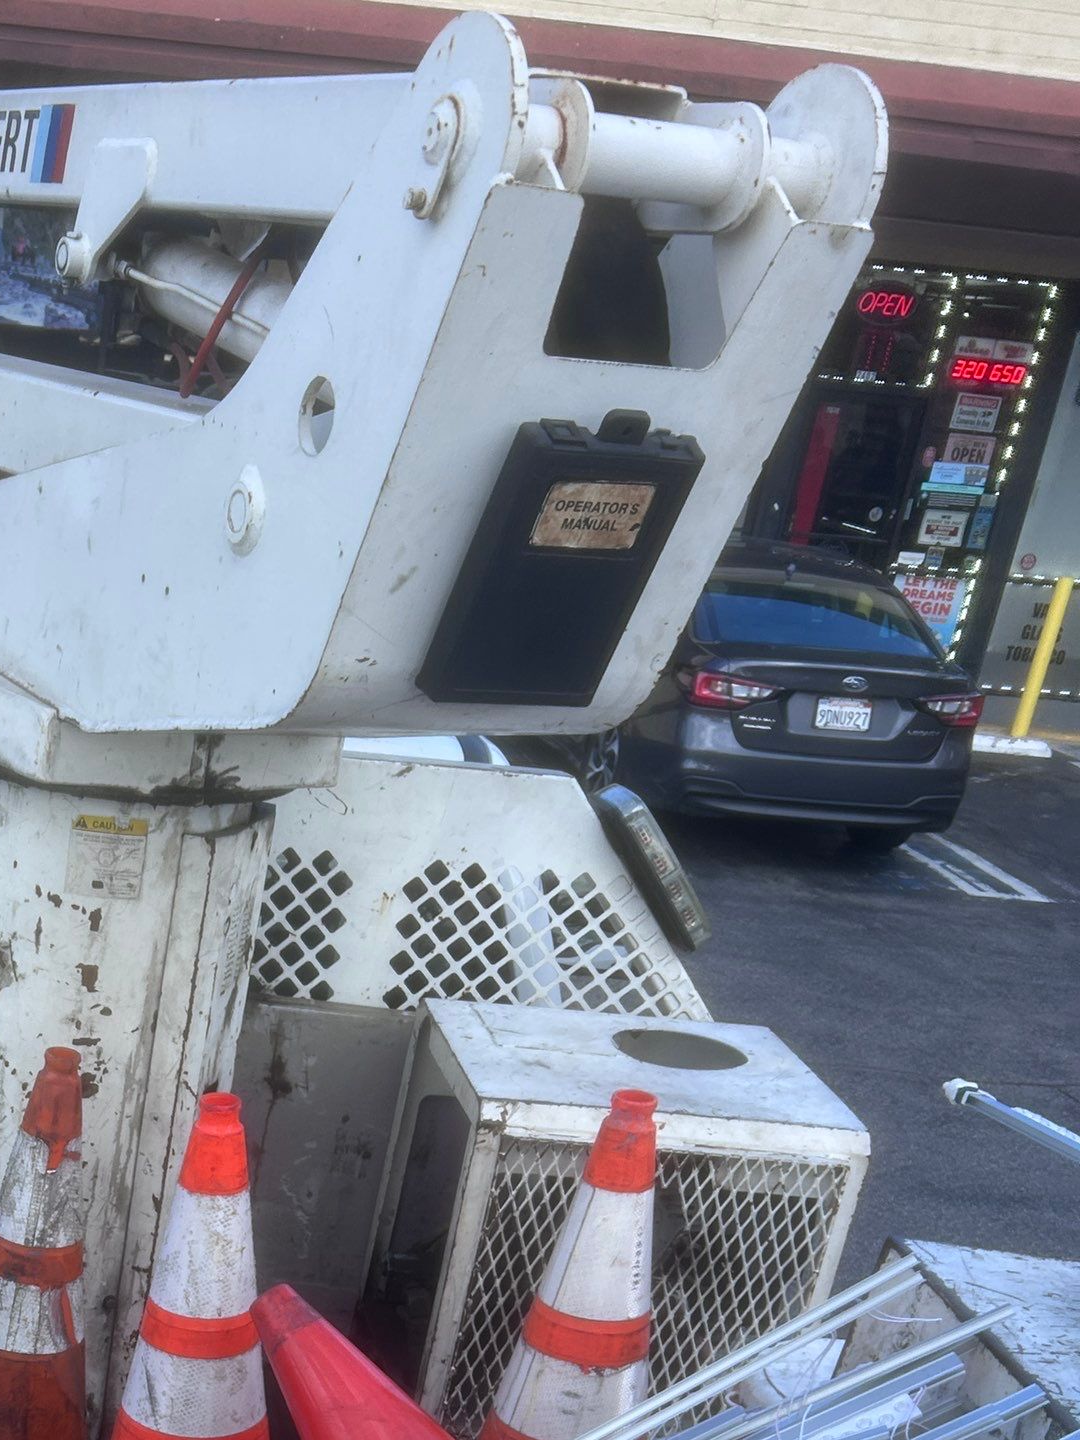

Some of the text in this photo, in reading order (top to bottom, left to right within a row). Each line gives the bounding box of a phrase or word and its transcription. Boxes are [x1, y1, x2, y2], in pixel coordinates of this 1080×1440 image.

[858, 291, 914, 317] OPEN
[951, 359, 1026, 384] 320 650
[951, 447, 986, 464] OPEN
[561, 517, 618, 532] MANUAL
[932, 577, 958, 590] THE
[902, 588, 955, 602] DREAMS
[911, 601, 952, 616] EGIN
[817, 708, 869, 728] 9DNU927
[92, 820, 134, 832] CAUTN
